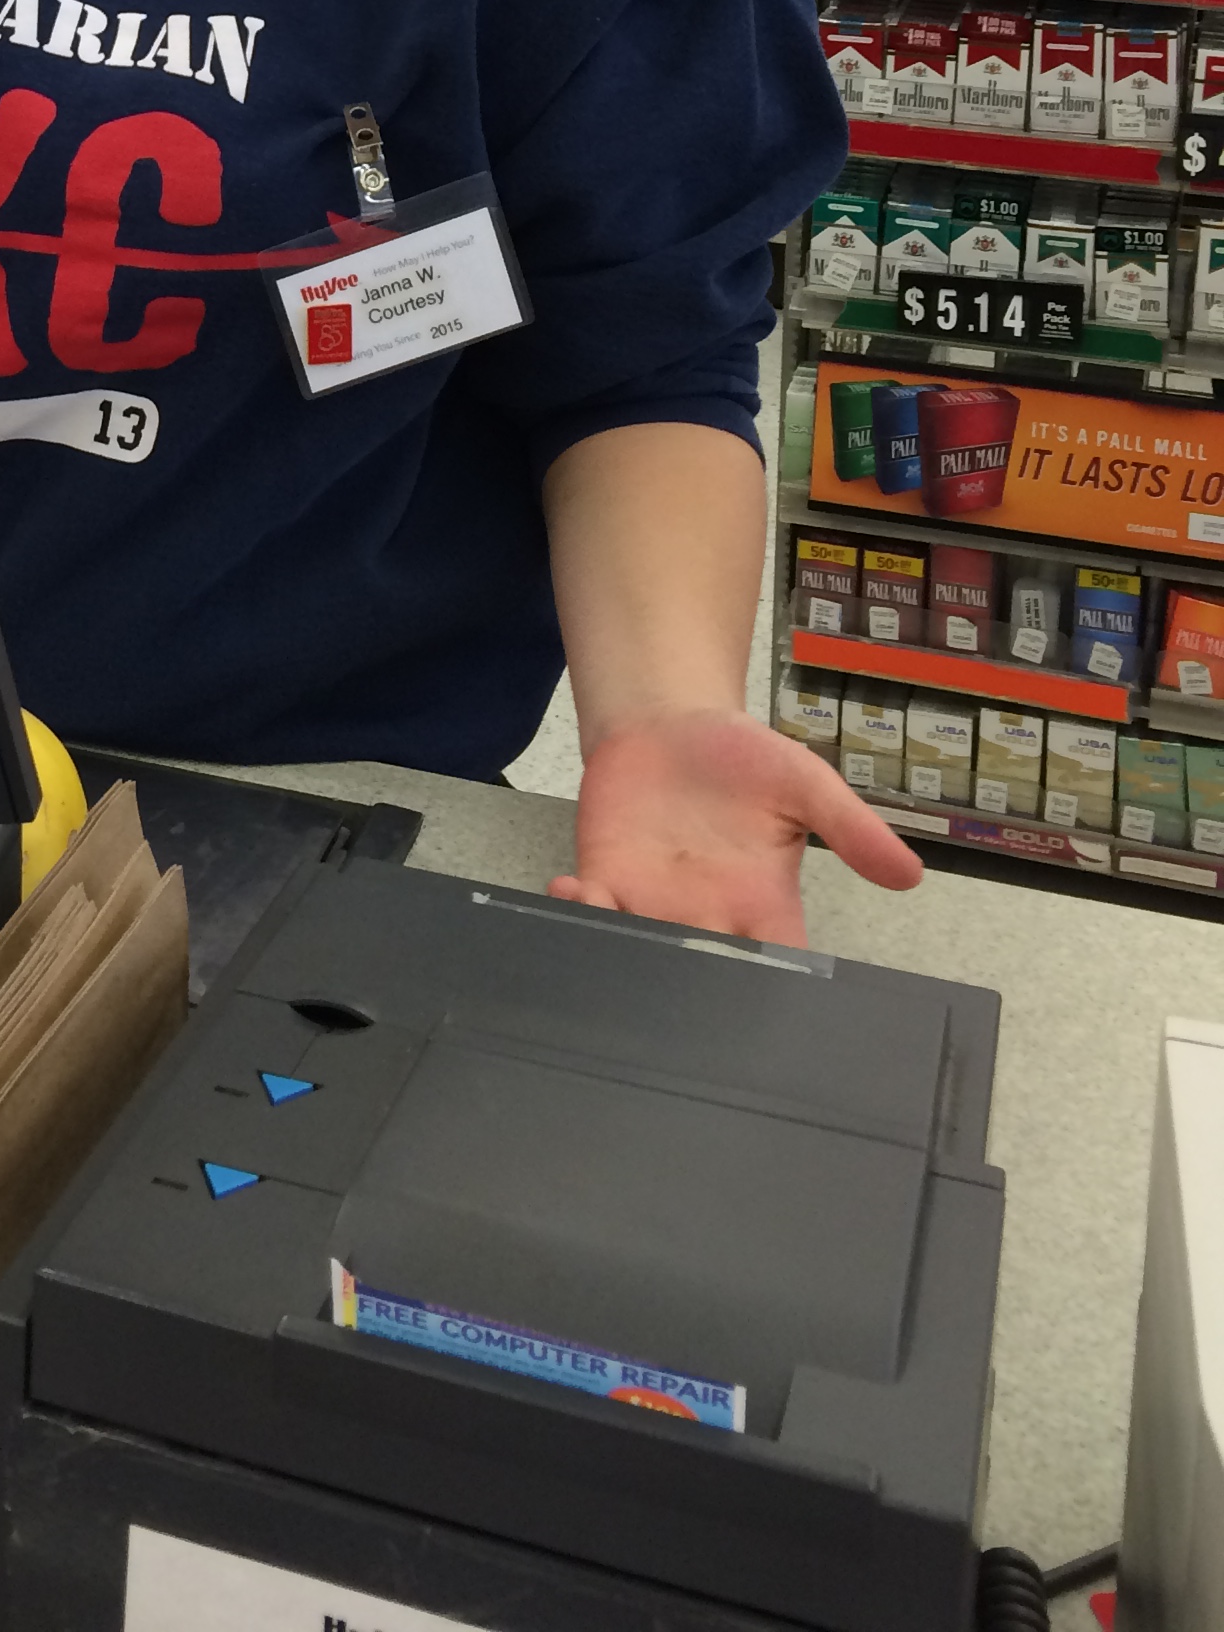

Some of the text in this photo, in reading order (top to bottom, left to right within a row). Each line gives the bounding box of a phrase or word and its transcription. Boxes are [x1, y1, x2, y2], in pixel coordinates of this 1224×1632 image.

[960, 80, 1024, 109] Marlboro
[980, 199, 1019, 217] $1.00
[1123, 230, 1164, 246] $1.00
[373, 264, 396, 277] How
[398, 256, 419, 271] May
[427, 246, 450, 260] Help
[450, 234, 475, 251] You?
[361, 265, 442, 305] Janna W.
[368, 289, 446, 324] Courtesy
[1047, 301, 1067, 313] Per
[430, 318, 464, 340] 2015
[1043, 313, 1071, 325] Pack
[93, 399, 147, 452] 13
[847, 429, 872, 450] PALL
[891, 437, 917, 458] PALL
[1031, 422, 1207, 462] IT'S A PALL MALL
[940, 447, 1007, 476] PALL MALL
[1018, 448, 1052, 480] IT
[1062, 452, 1170, 498] LASTS
[801, 570, 852, 595] PALL MALL
[867, 582, 918, 606] PALL MALL
[935, 583, 989, 608] PALL MALL
[1078, 608, 1135, 633] PALL MALL
[802, 707, 833, 719] USA
[865, 719, 897, 732] USA
[936, 724, 968, 737] USA
[1004, 725, 1038, 739] USA
[1078, 737, 1110, 751] USA
[1002, 827, 1065, 850] GOLD
[358, 1297, 428, 1331] FREE
[441, 1319, 608, 1379] COMPUTER
[621, 1364, 731, 1410] REPAIR
